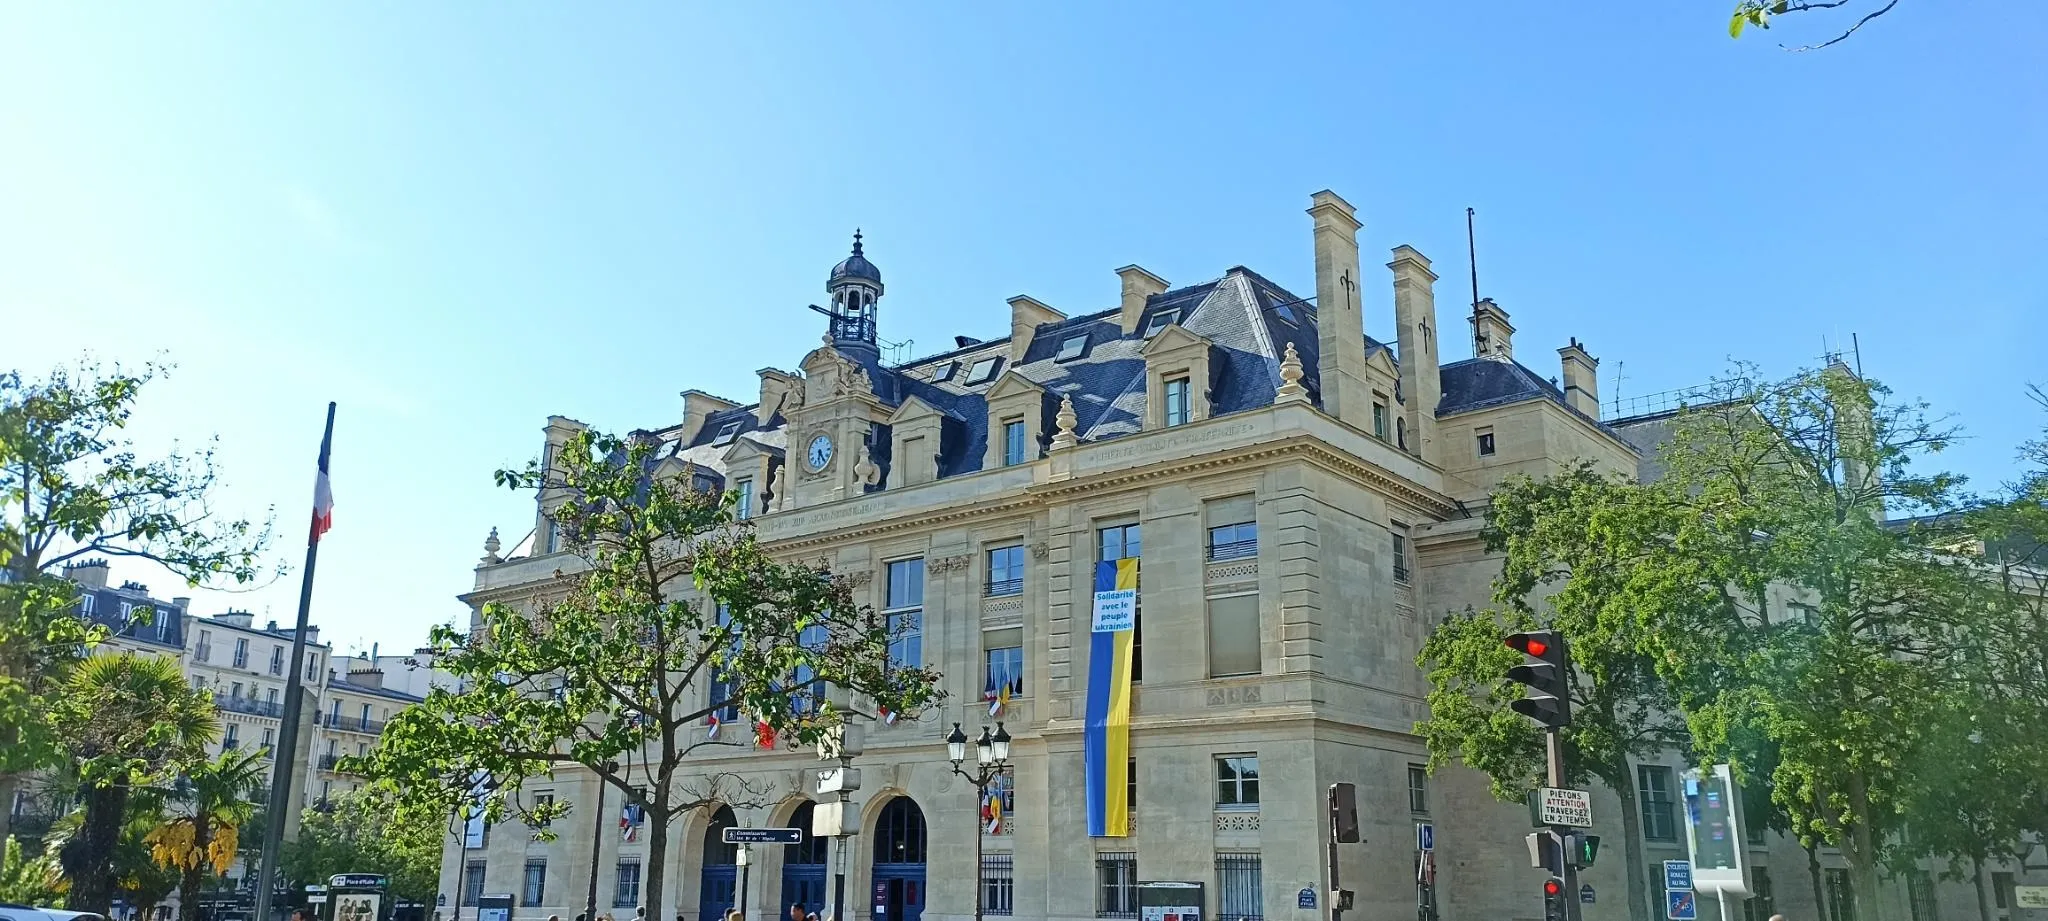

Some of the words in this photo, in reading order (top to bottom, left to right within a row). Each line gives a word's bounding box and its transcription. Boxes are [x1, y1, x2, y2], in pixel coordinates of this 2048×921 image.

[1101, 612, 1128, 621] peuple
[1095, 622, 1132, 631] ukrainien
[1547, 799, 1586, 808] ATTENTION
[1546, 806, 1588, 817] TRAVERSEZ
[1566, 817, 1590, 825] TEMPS
